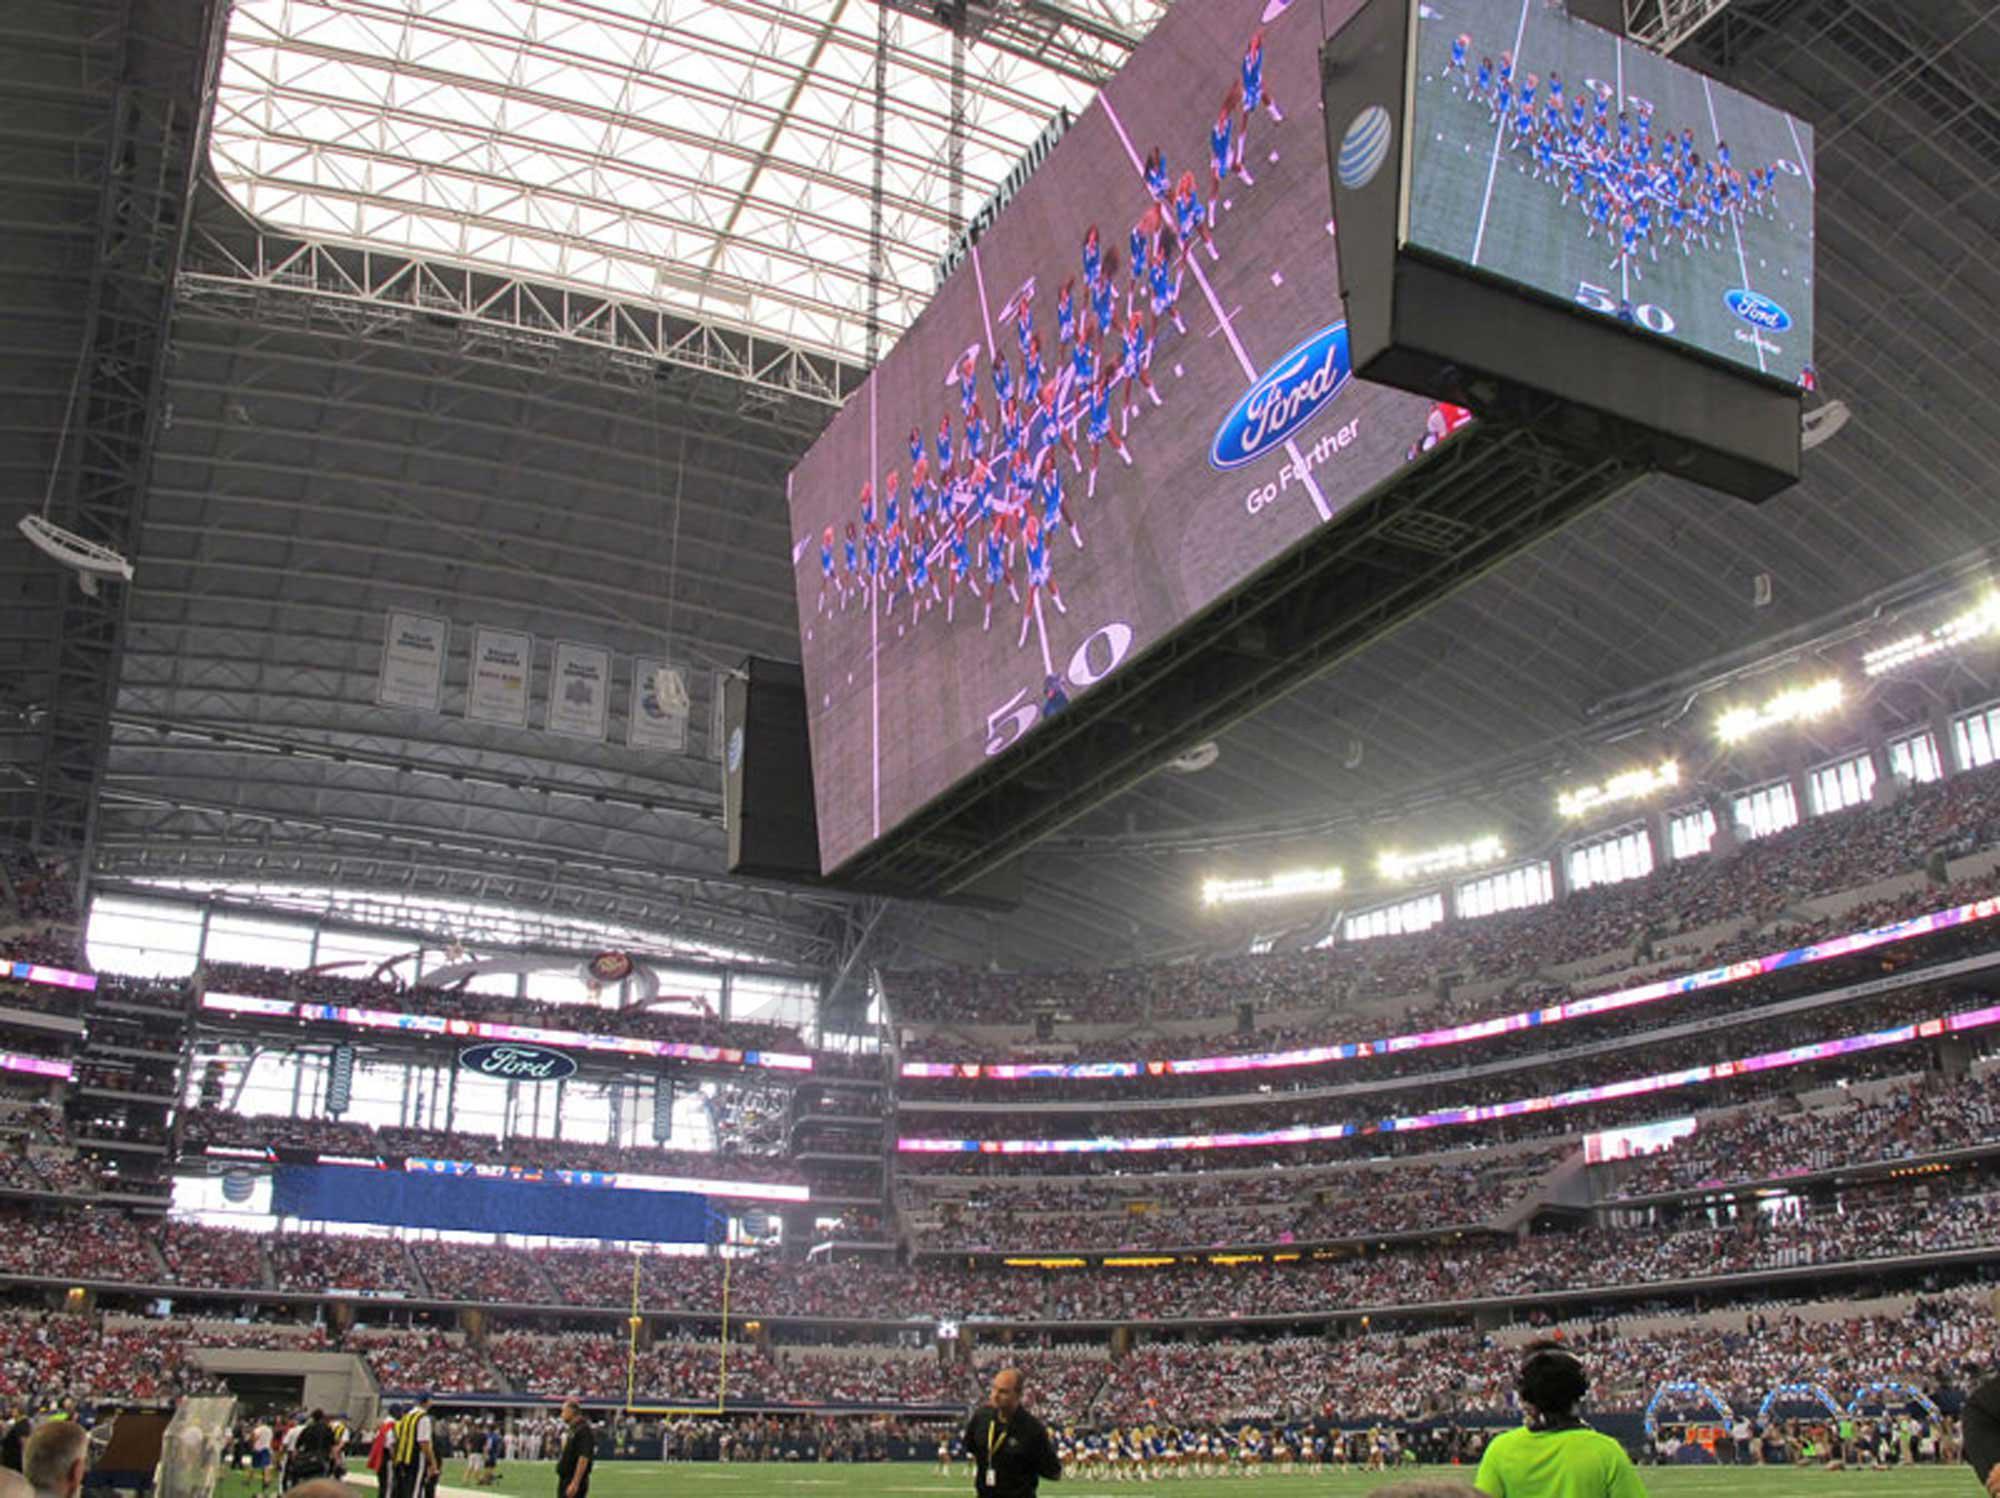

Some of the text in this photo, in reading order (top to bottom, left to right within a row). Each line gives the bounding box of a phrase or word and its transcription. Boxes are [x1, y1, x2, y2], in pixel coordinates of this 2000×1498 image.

[1736, 296, 1779, 327] Ford
[1241, 344, 1337, 452] Ford
[1246, 481, 1278, 515] Go
[481, 1047, 555, 1077] Ford
